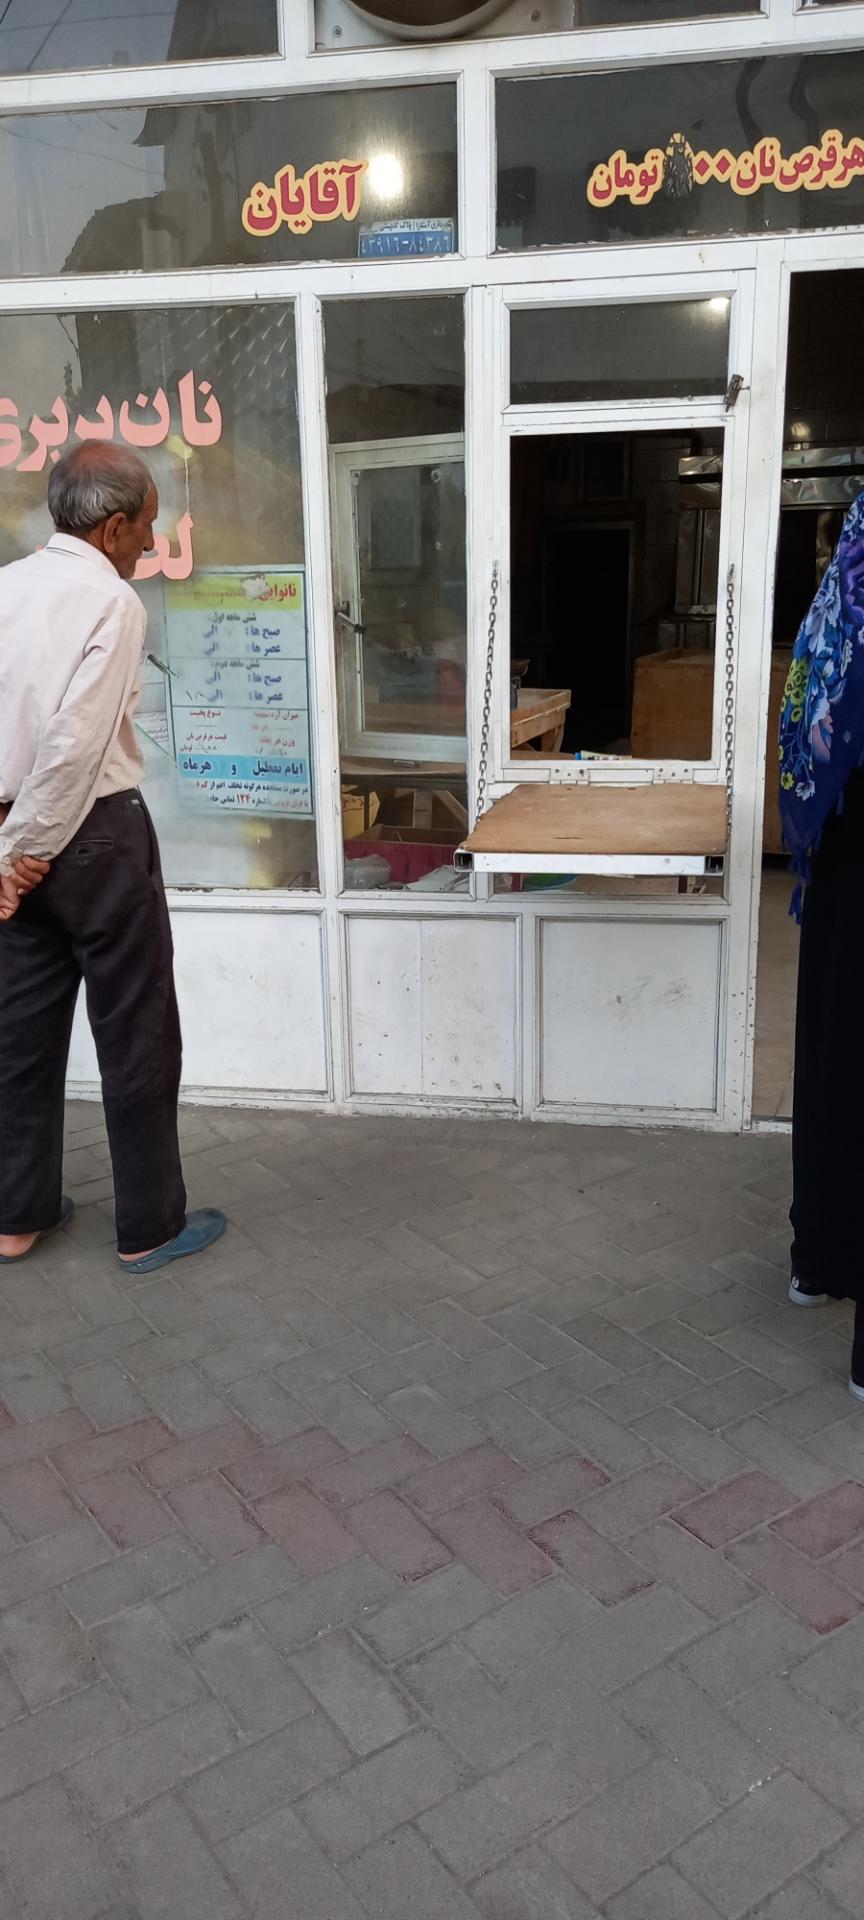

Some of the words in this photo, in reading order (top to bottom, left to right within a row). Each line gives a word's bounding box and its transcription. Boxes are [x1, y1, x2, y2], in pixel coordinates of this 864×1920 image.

[734, 142, 779, 190] نان
[590, 152, 661, 203] تومان
[246, 162, 365, 232] آقایان
[119, 369, 222, 447] نان
[203, 625, 218, 639] الی
[262, 627, 281, 639] صبح
[204, 642, 219, 657] الی
[264, 644, 281, 657] عصر
[206, 671, 221, 685] الی
[264, 673, 282, 686] صبح
[208, 689, 223, 703] الی
[266, 691, 283, 704] عصر
[231, 764, 237, 775] و
[253, 760, 282, 776] تعطیل
[284, 762, 303, 778] ایام
[236, 793, 251, 805] ۱۲۴
